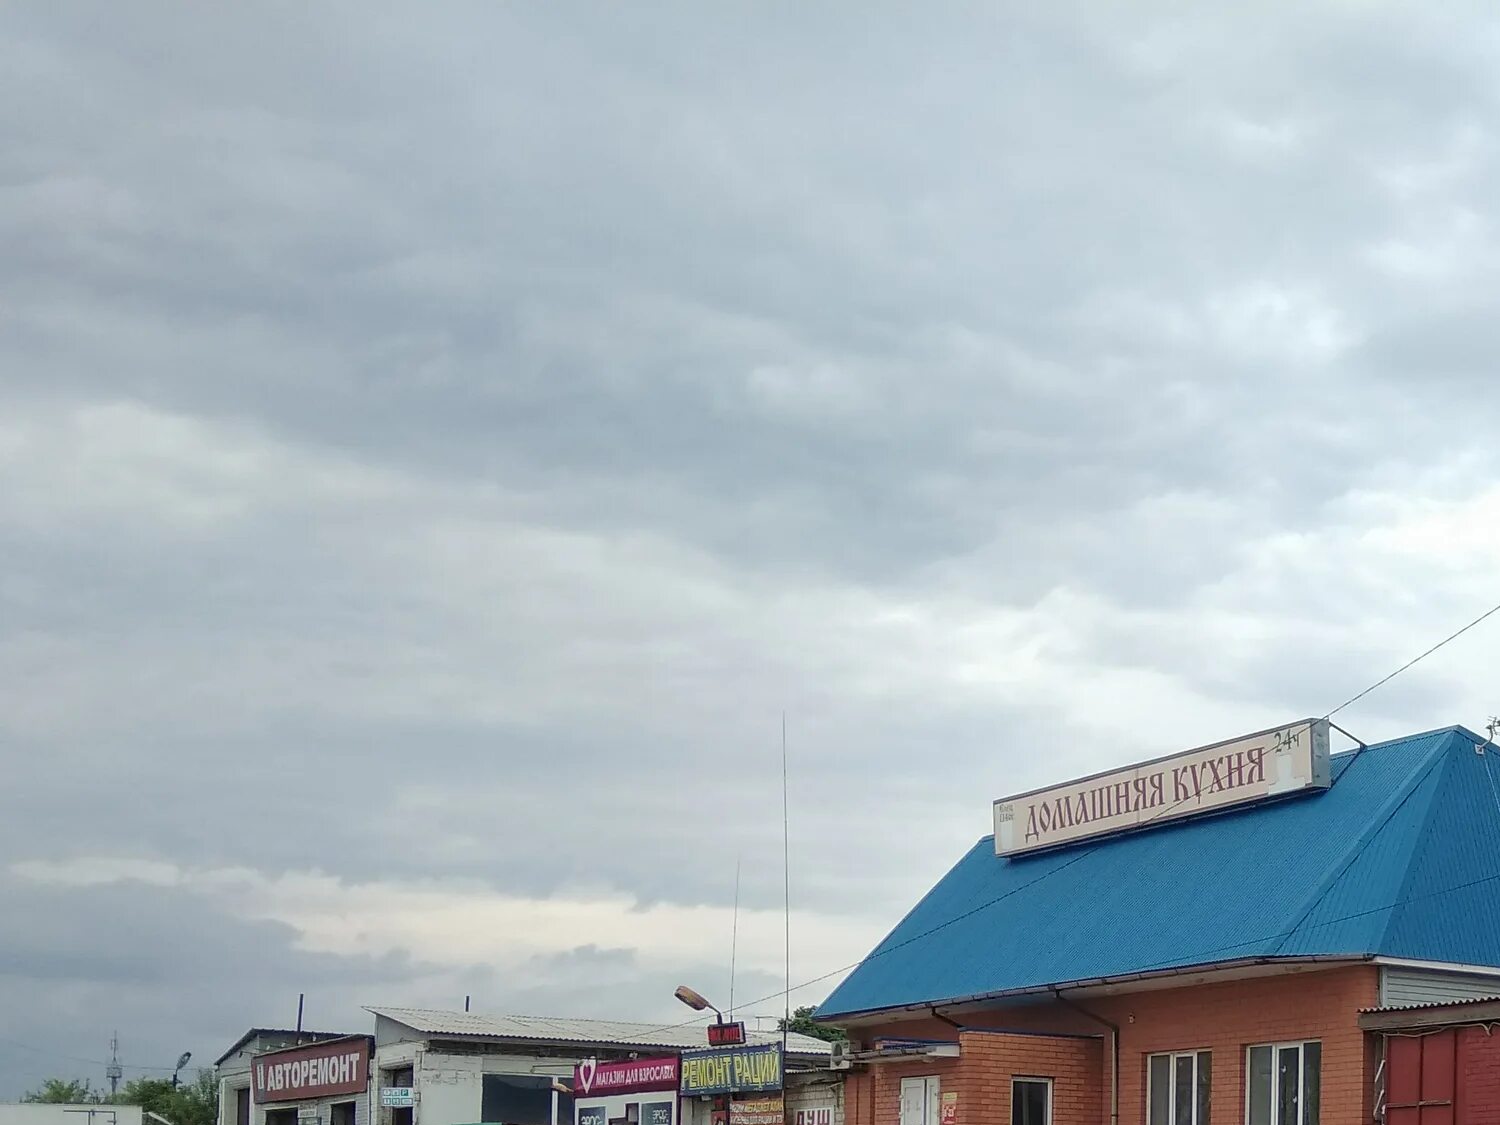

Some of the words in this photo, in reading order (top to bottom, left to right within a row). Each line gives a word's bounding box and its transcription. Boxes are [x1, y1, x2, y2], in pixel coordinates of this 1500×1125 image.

[1025, 772, 1165, 844] ДОМАШНЯЯ
[1171, 747, 1266, 805] КУХНЯ
[267, 1053, 360, 1091] АВТОРЕМОНТ
[596, 1070, 625, 1086] МАГАЗИН
[625, 1068, 639, 1085] ДЛЯ
[681, 1054, 732, 1091] РЕМОНТ
[733, 1045, 780, 1089] РАЦИЙ
